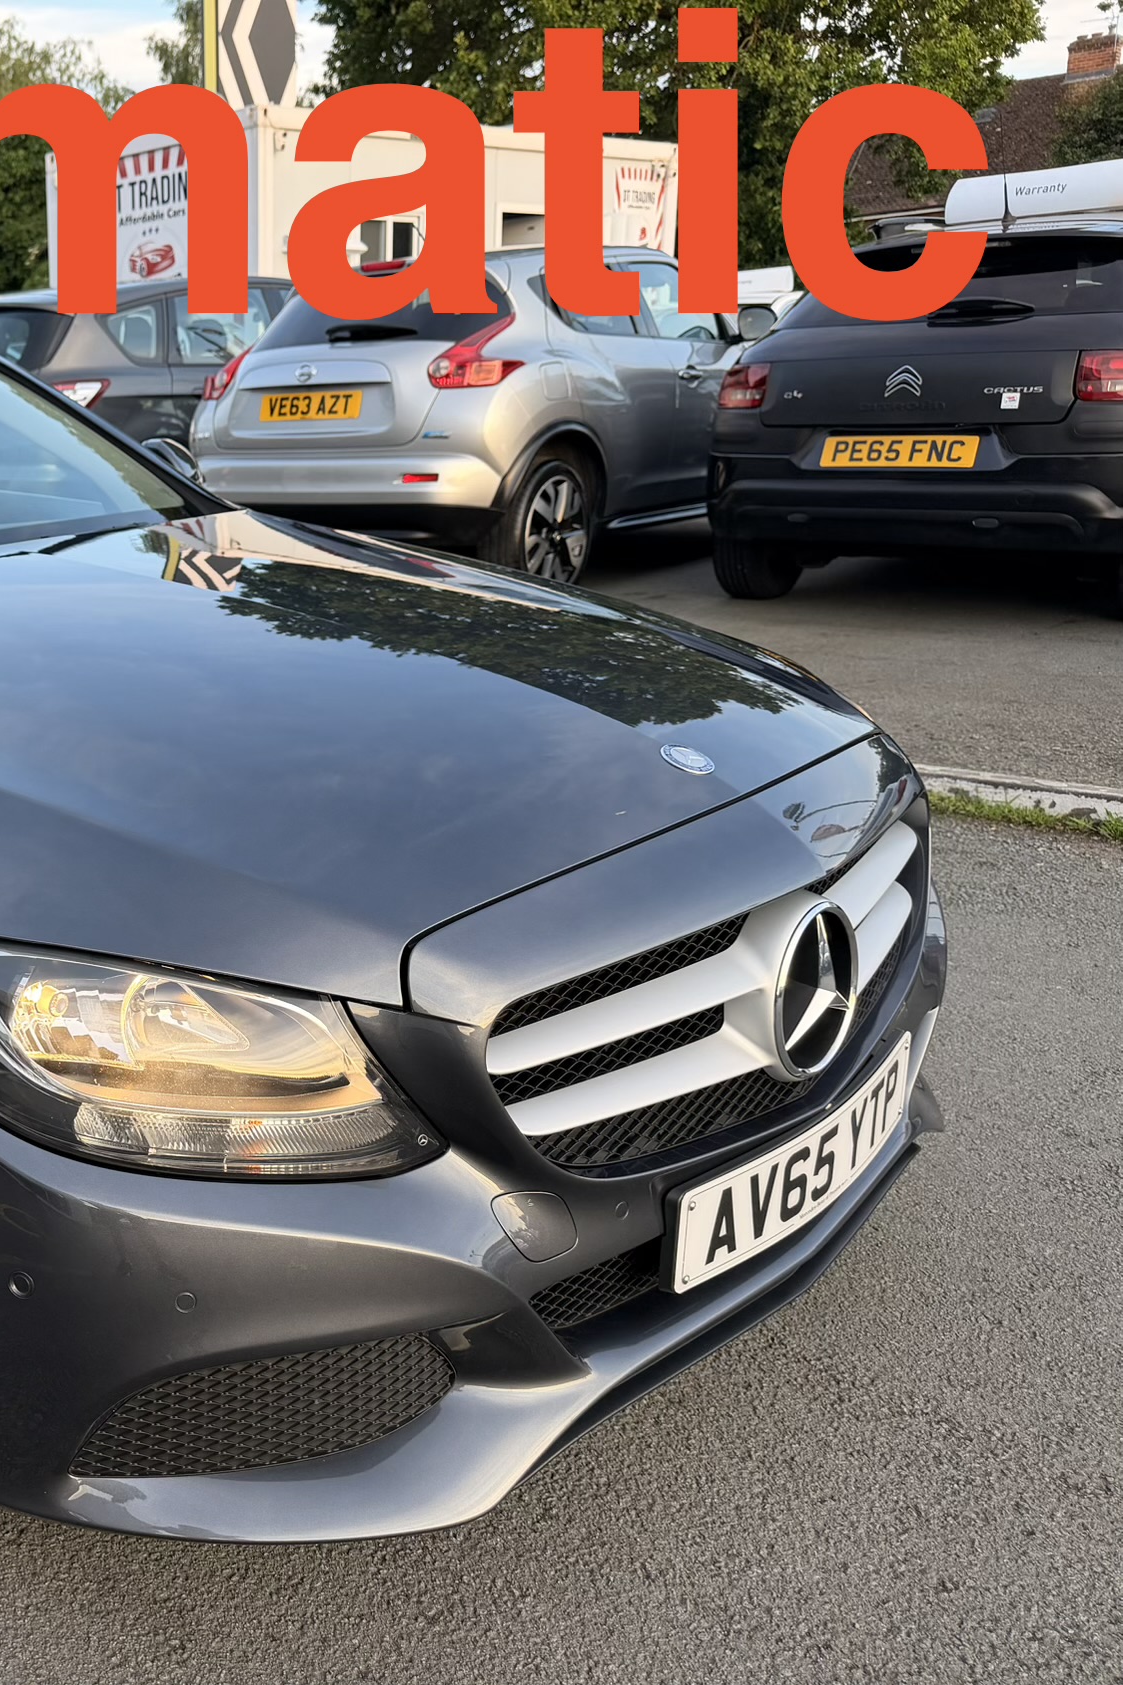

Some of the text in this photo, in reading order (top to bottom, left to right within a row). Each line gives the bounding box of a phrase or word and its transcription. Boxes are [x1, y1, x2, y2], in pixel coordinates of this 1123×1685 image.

[129, 171, 188, 211] TRADIN
[1015, 183, 1067, 197] Warranty
[119, 207, 186, 226] Affordable Cars
[983, 385, 1044, 395] CACTUS
[269, 394, 353, 417] VE63 AZT
[831, 440, 965, 462] PE65 FNC
[705, 1059, 899, 1266] AV65 YTP
